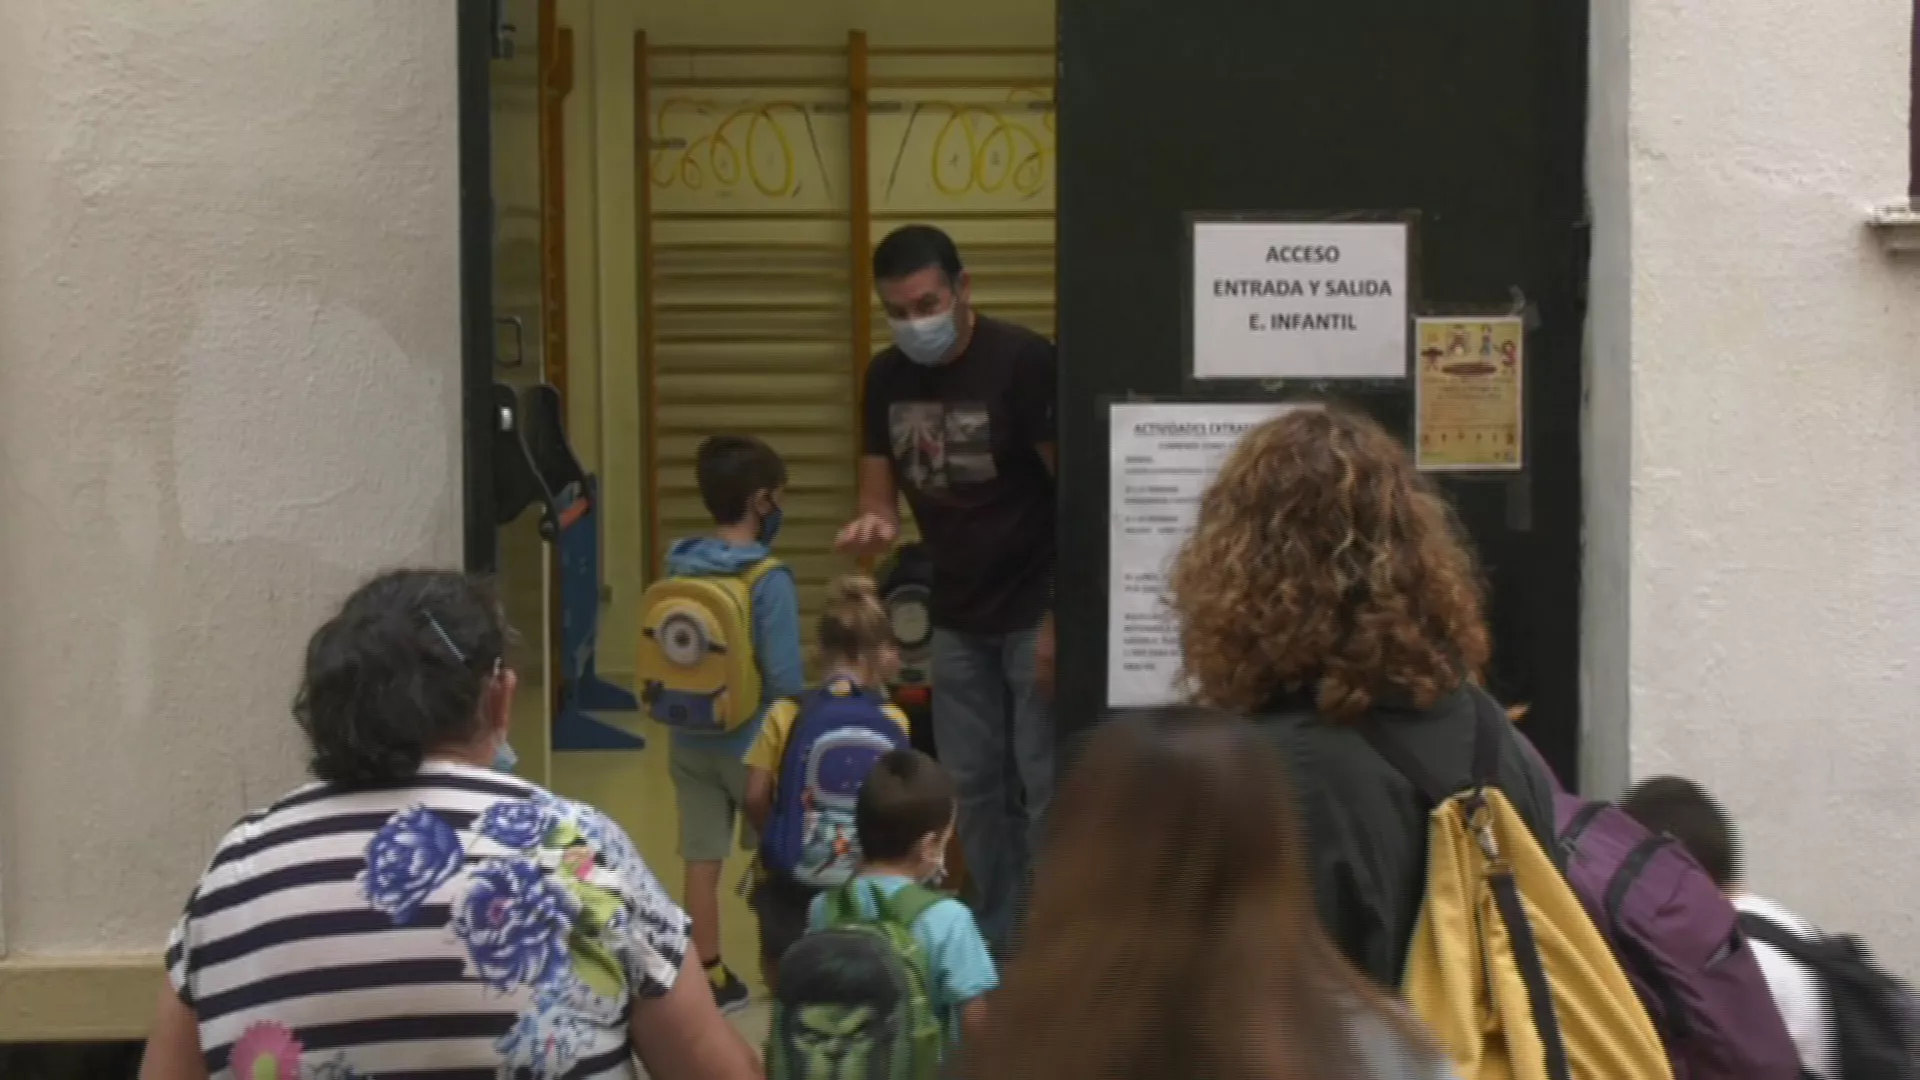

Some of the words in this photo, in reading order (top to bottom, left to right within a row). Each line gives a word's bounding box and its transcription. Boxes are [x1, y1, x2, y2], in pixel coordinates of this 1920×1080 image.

[1265, 245, 1340, 263] ACCESO
[1213, 279, 1304, 297] ENTRADA
[1308, 279, 1320, 297] Y
[1325, 279, 1392, 297] SALIDA
[1249, 313, 1265, 331] E.
[1270, 312, 1357, 331] INFANTIL
